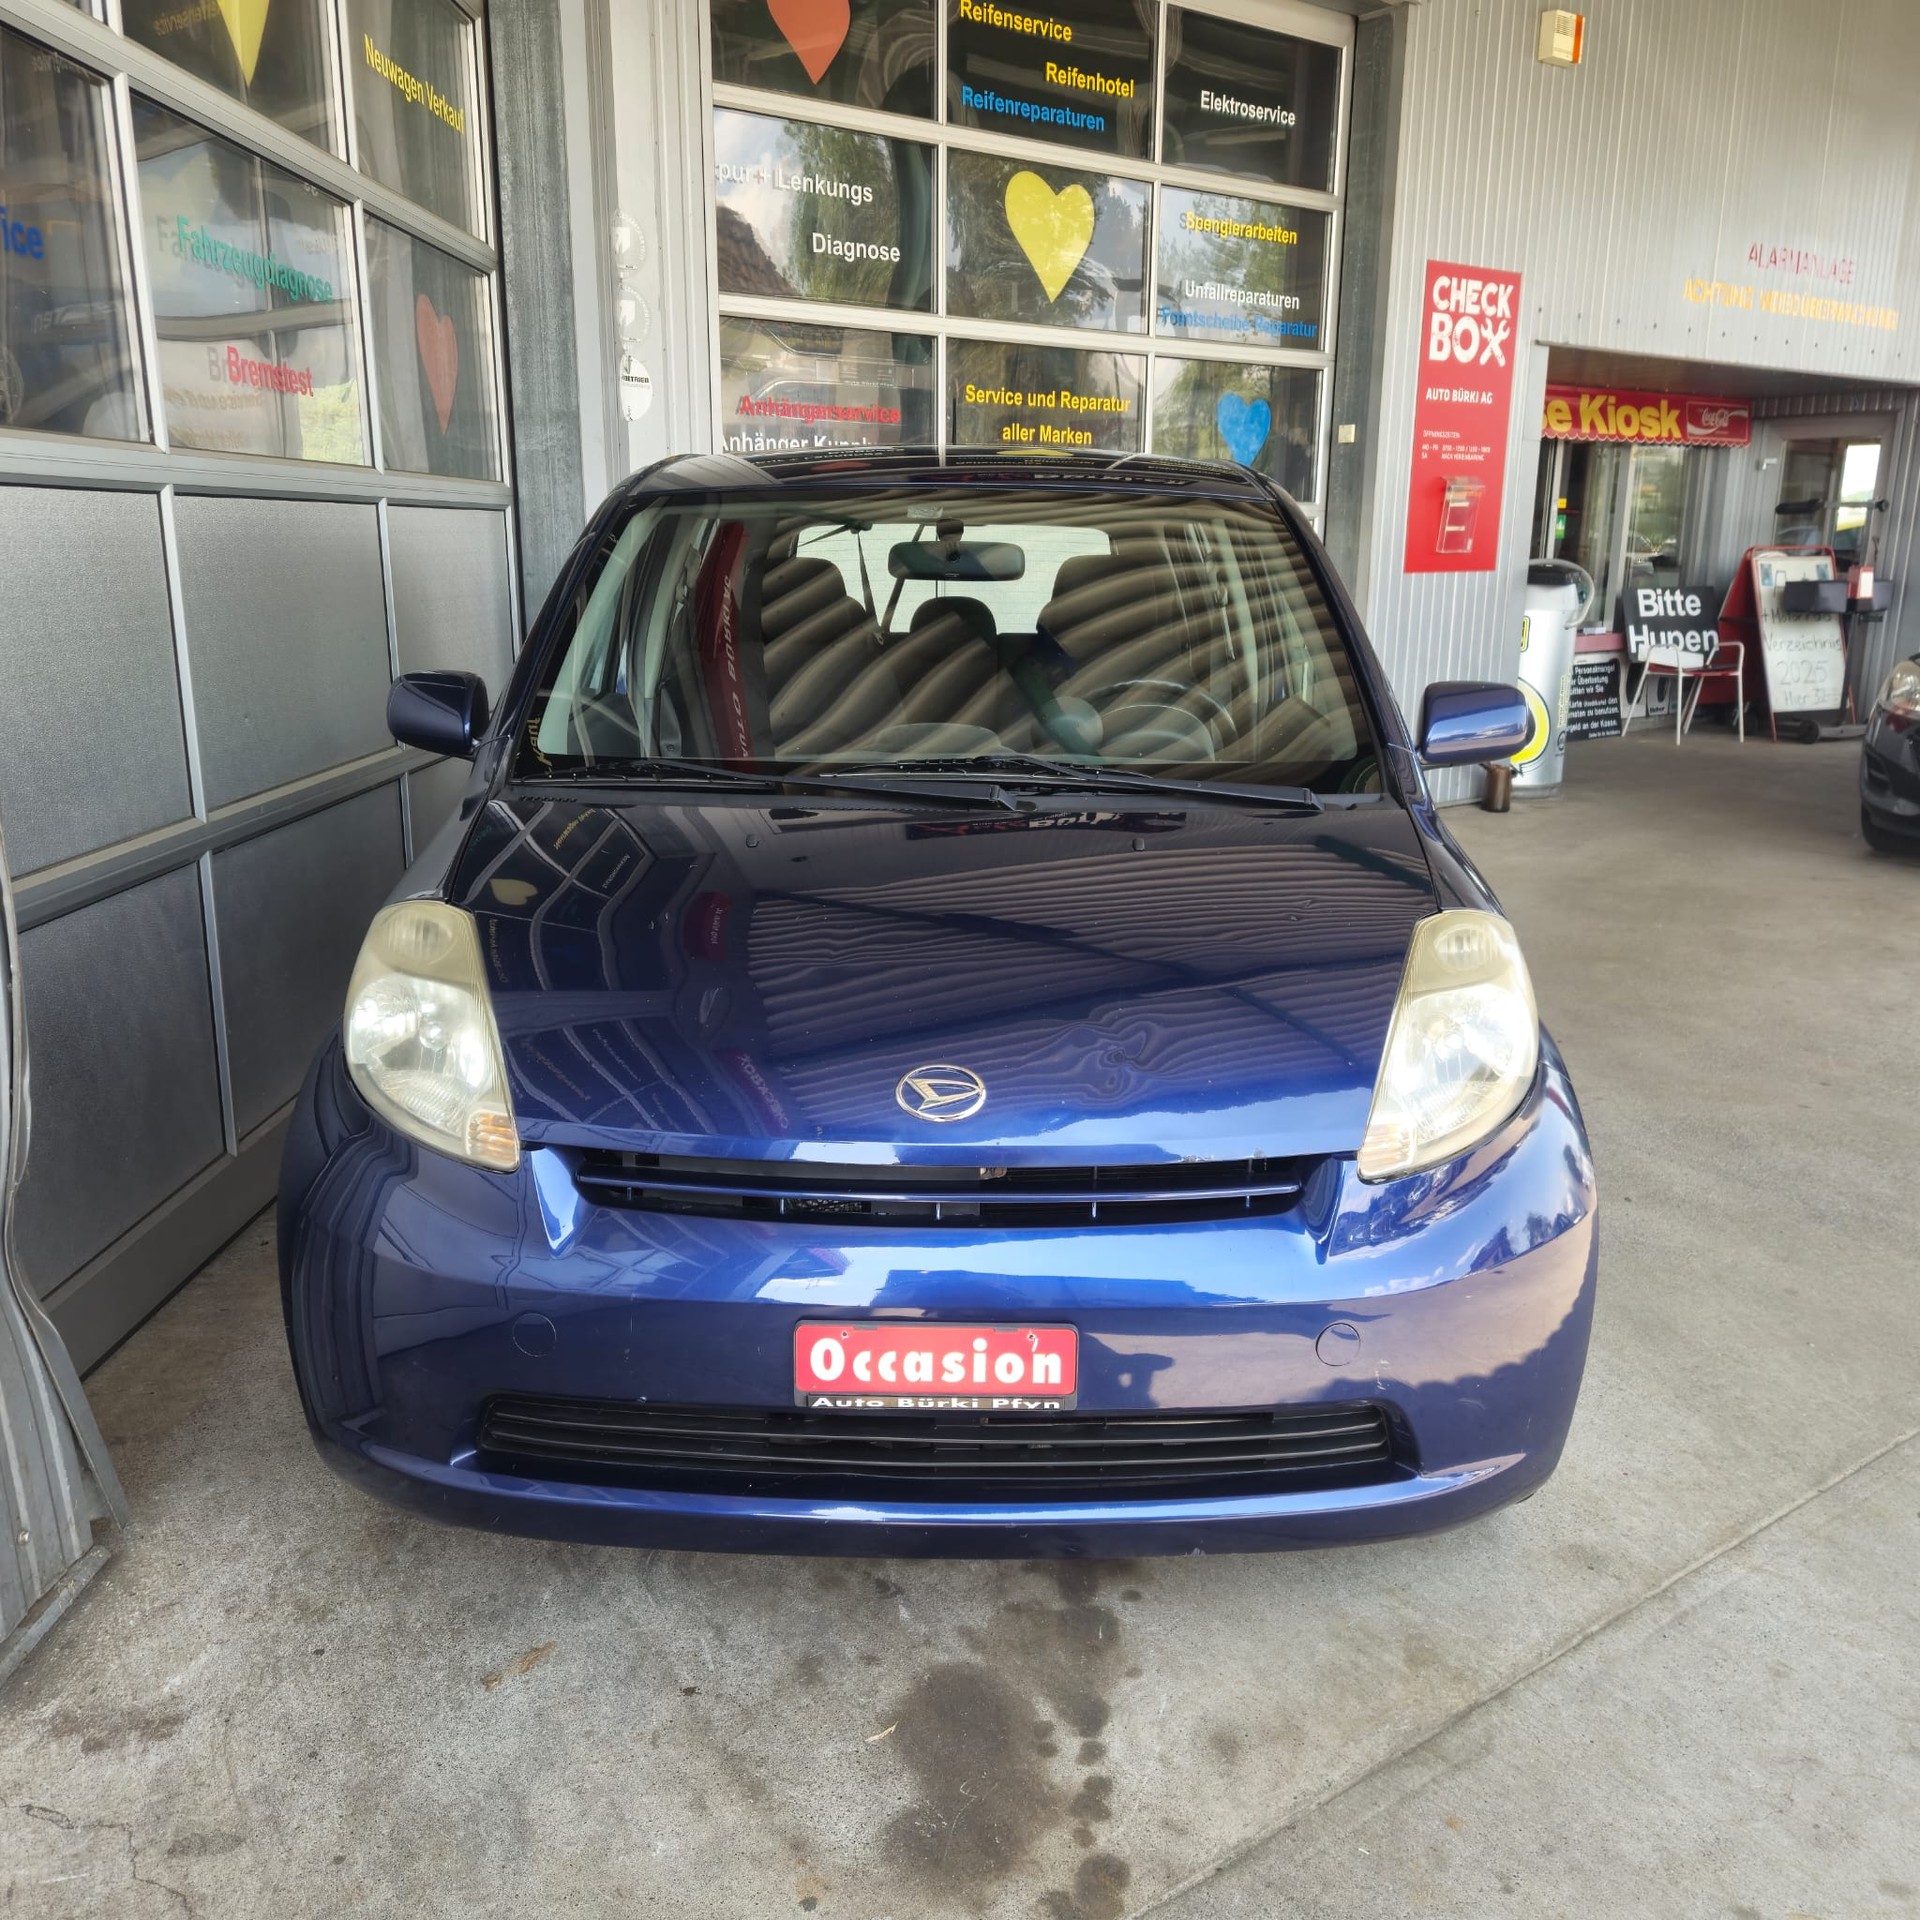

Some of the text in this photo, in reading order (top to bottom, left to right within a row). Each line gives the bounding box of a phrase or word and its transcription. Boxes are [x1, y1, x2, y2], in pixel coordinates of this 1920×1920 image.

[960, 0, 1072, 42] Reifenservice
[364, 34, 464, 134] Neuwagen Verkauf
[1045, 61, 1135, 98] Reifenhotel
[961, 85, 1105, 132] Reifenreparaturen
[1200, 90, 1296, 126] Elektroservice
[714, 163, 752, 184] pur
[777, 165, 873, 206] Lenkungs
[1185, 211, 1298, 245] Spenglerarbeiten
[177, 215, 333, 304] Fahrzeugdiagnose
[812, 232, 901, 262] Diagnose
[1184, 279, 1300, 310] Unfallreparaturen
[1433, 275, 1514, 319] CHECK
[1683, 276, 1753, 310] ACHTUNG
[1254, 313, 1317, 338] Reparatur
[226, 345, 314, 398] Bremstest
[739, 394, 902, 425] Anhängerservice
[965, 384, 1131, 413] Service und Reparatur
[1426, 387, 1493, 405] AUTO BÜRKI AG
[1542, 394, 1682, 439] e Kiosk
[1002, 424, 1093, 445] aller Marken
[1637, 588, 1701, 618] Bitte
[1628, 624, 1720, 656] Hupen
[1776, 659, 1829, 686] 2025
[810, 1337, 1062, 1384] Occasion
[810, 1397, 1061, 1411] Auto Bürki Pfyn
